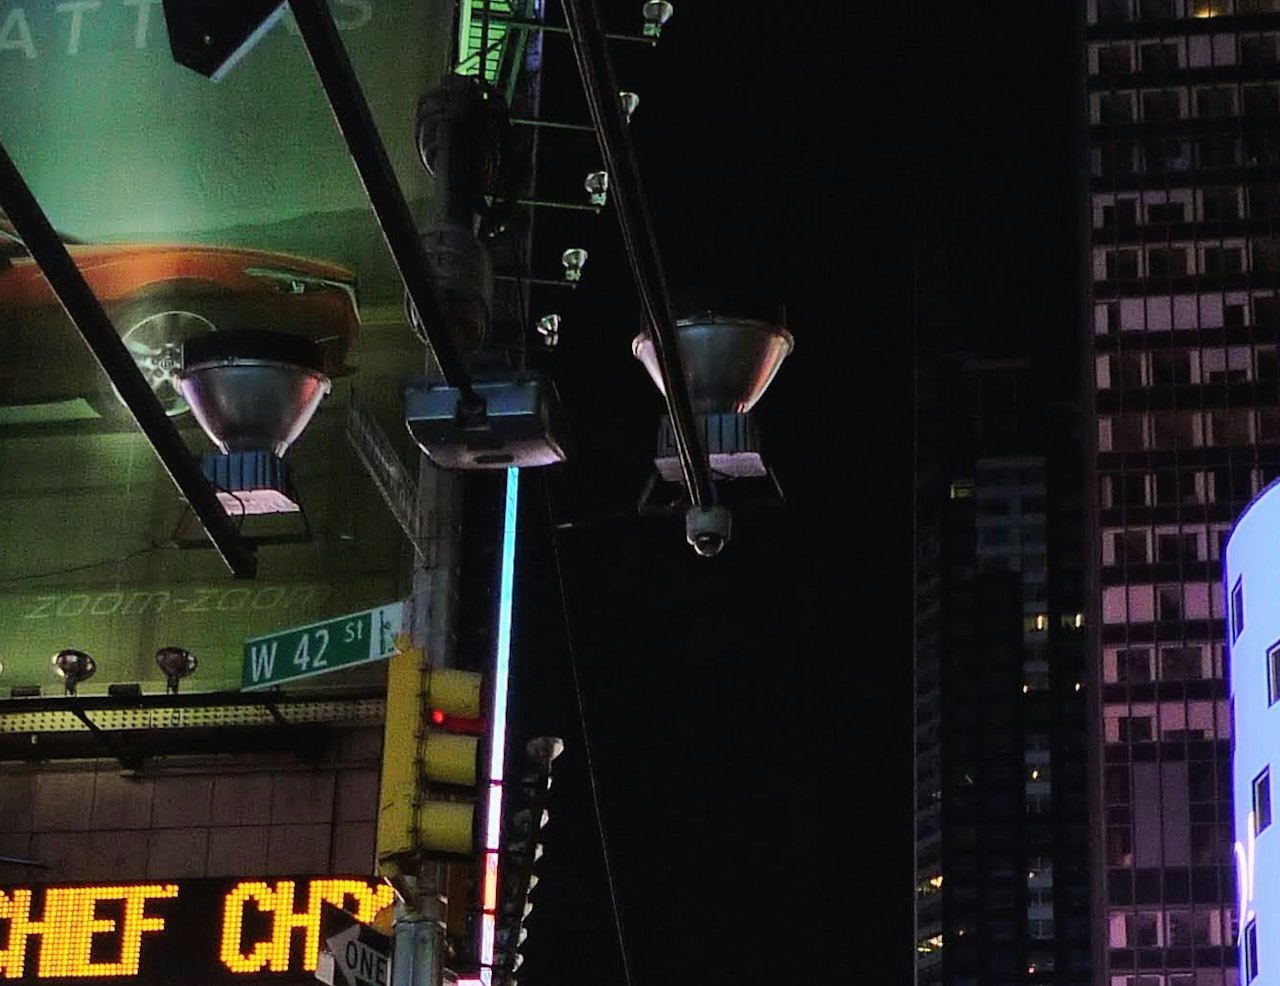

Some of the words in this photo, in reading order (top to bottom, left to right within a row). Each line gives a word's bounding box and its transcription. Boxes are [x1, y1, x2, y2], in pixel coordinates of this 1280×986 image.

[250, 646, 278, 682] W
[293, 629, 329, 671] 42
[344, 620, 363, 643] St
